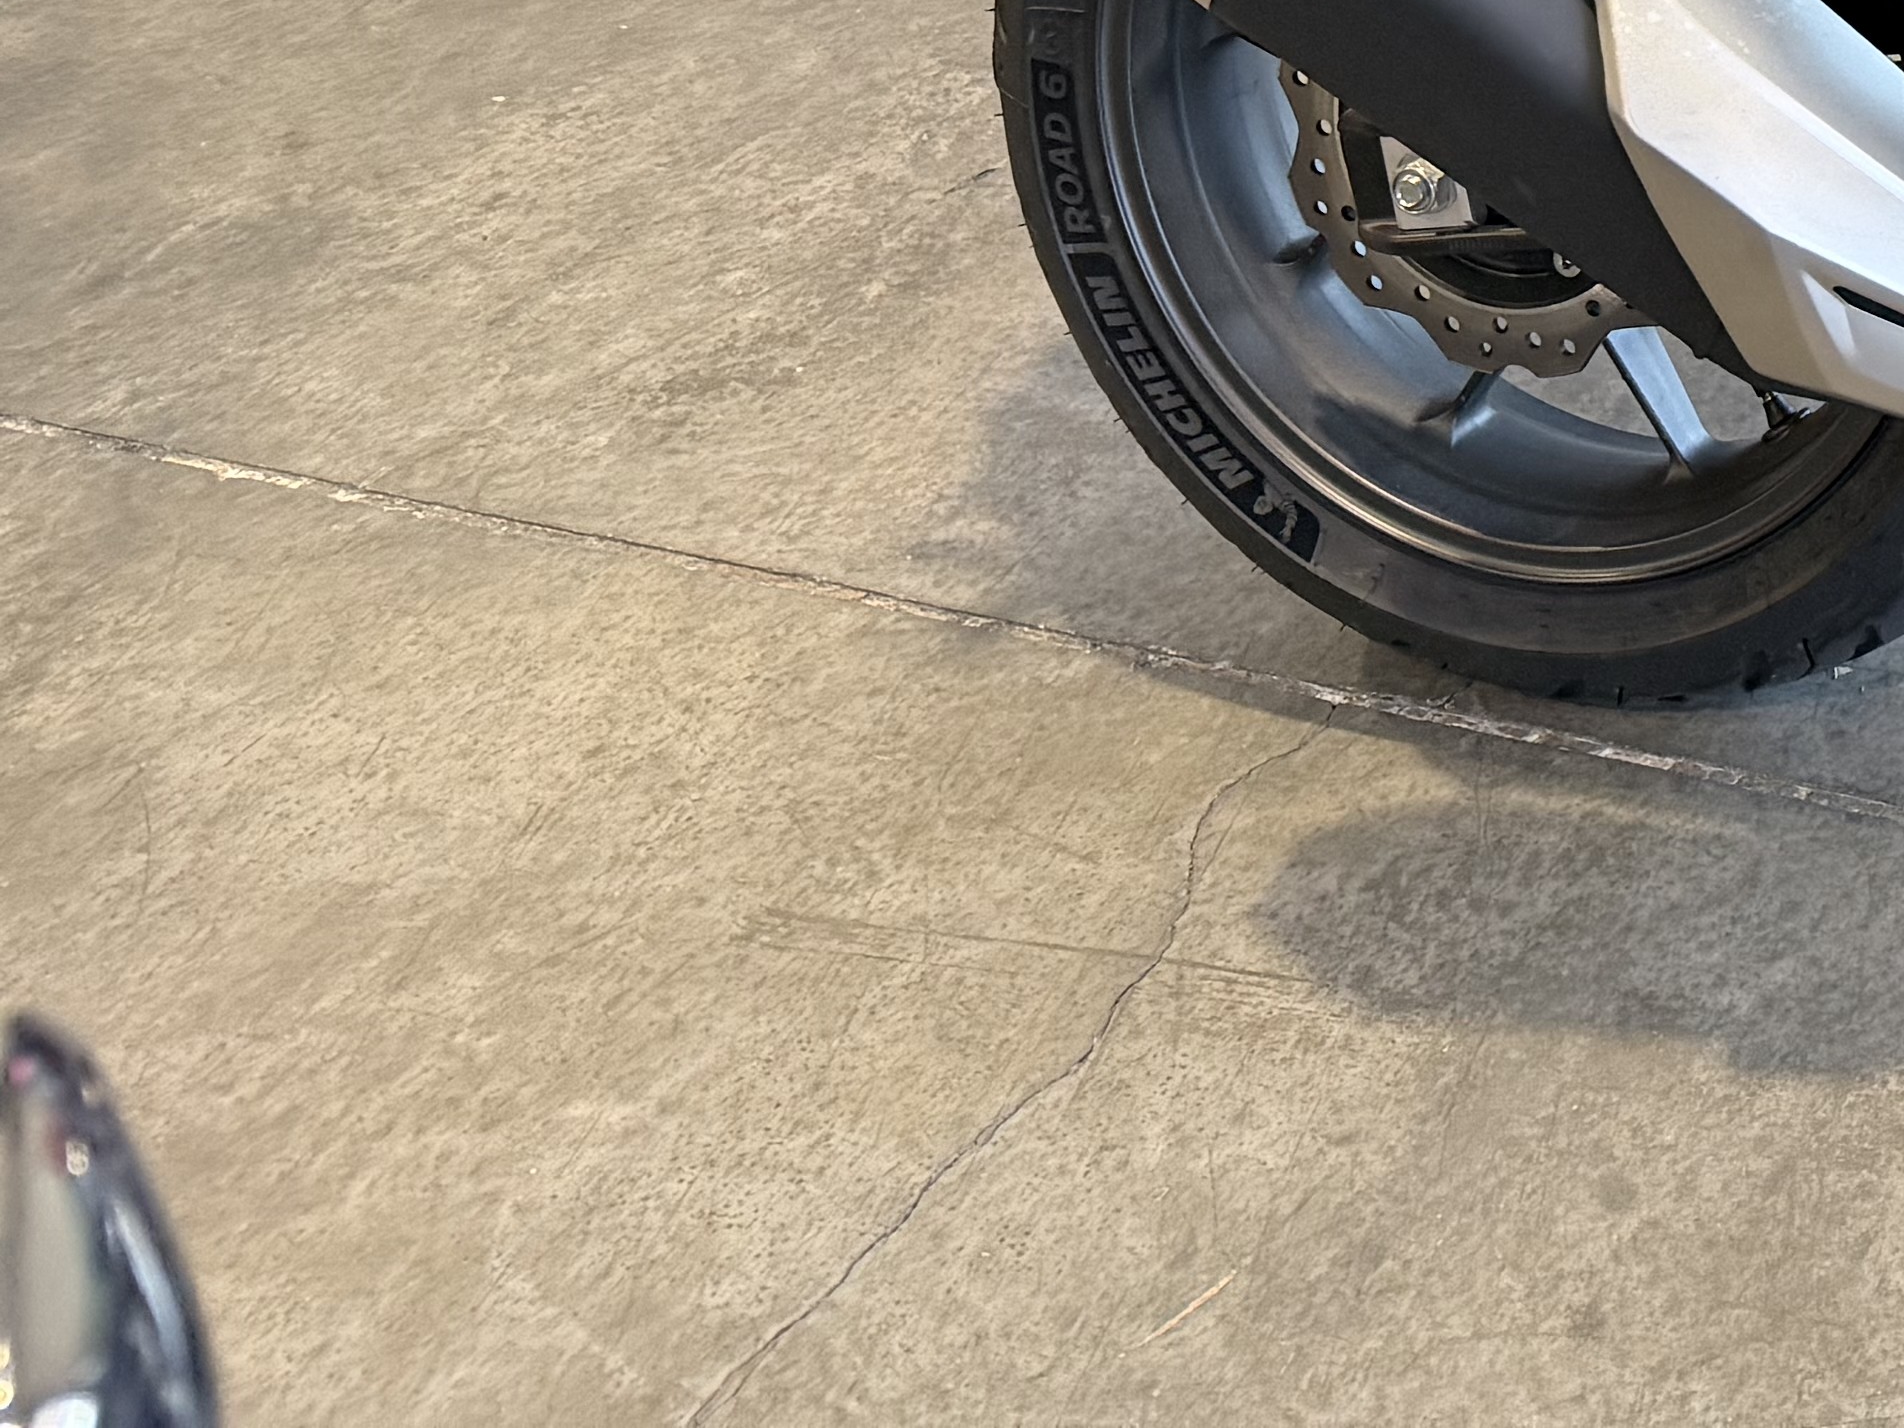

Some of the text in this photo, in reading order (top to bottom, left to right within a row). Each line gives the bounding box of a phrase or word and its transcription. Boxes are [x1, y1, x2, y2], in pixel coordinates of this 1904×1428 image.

[1039, 69, 1255, 490] MICHELIN ROAD 6
